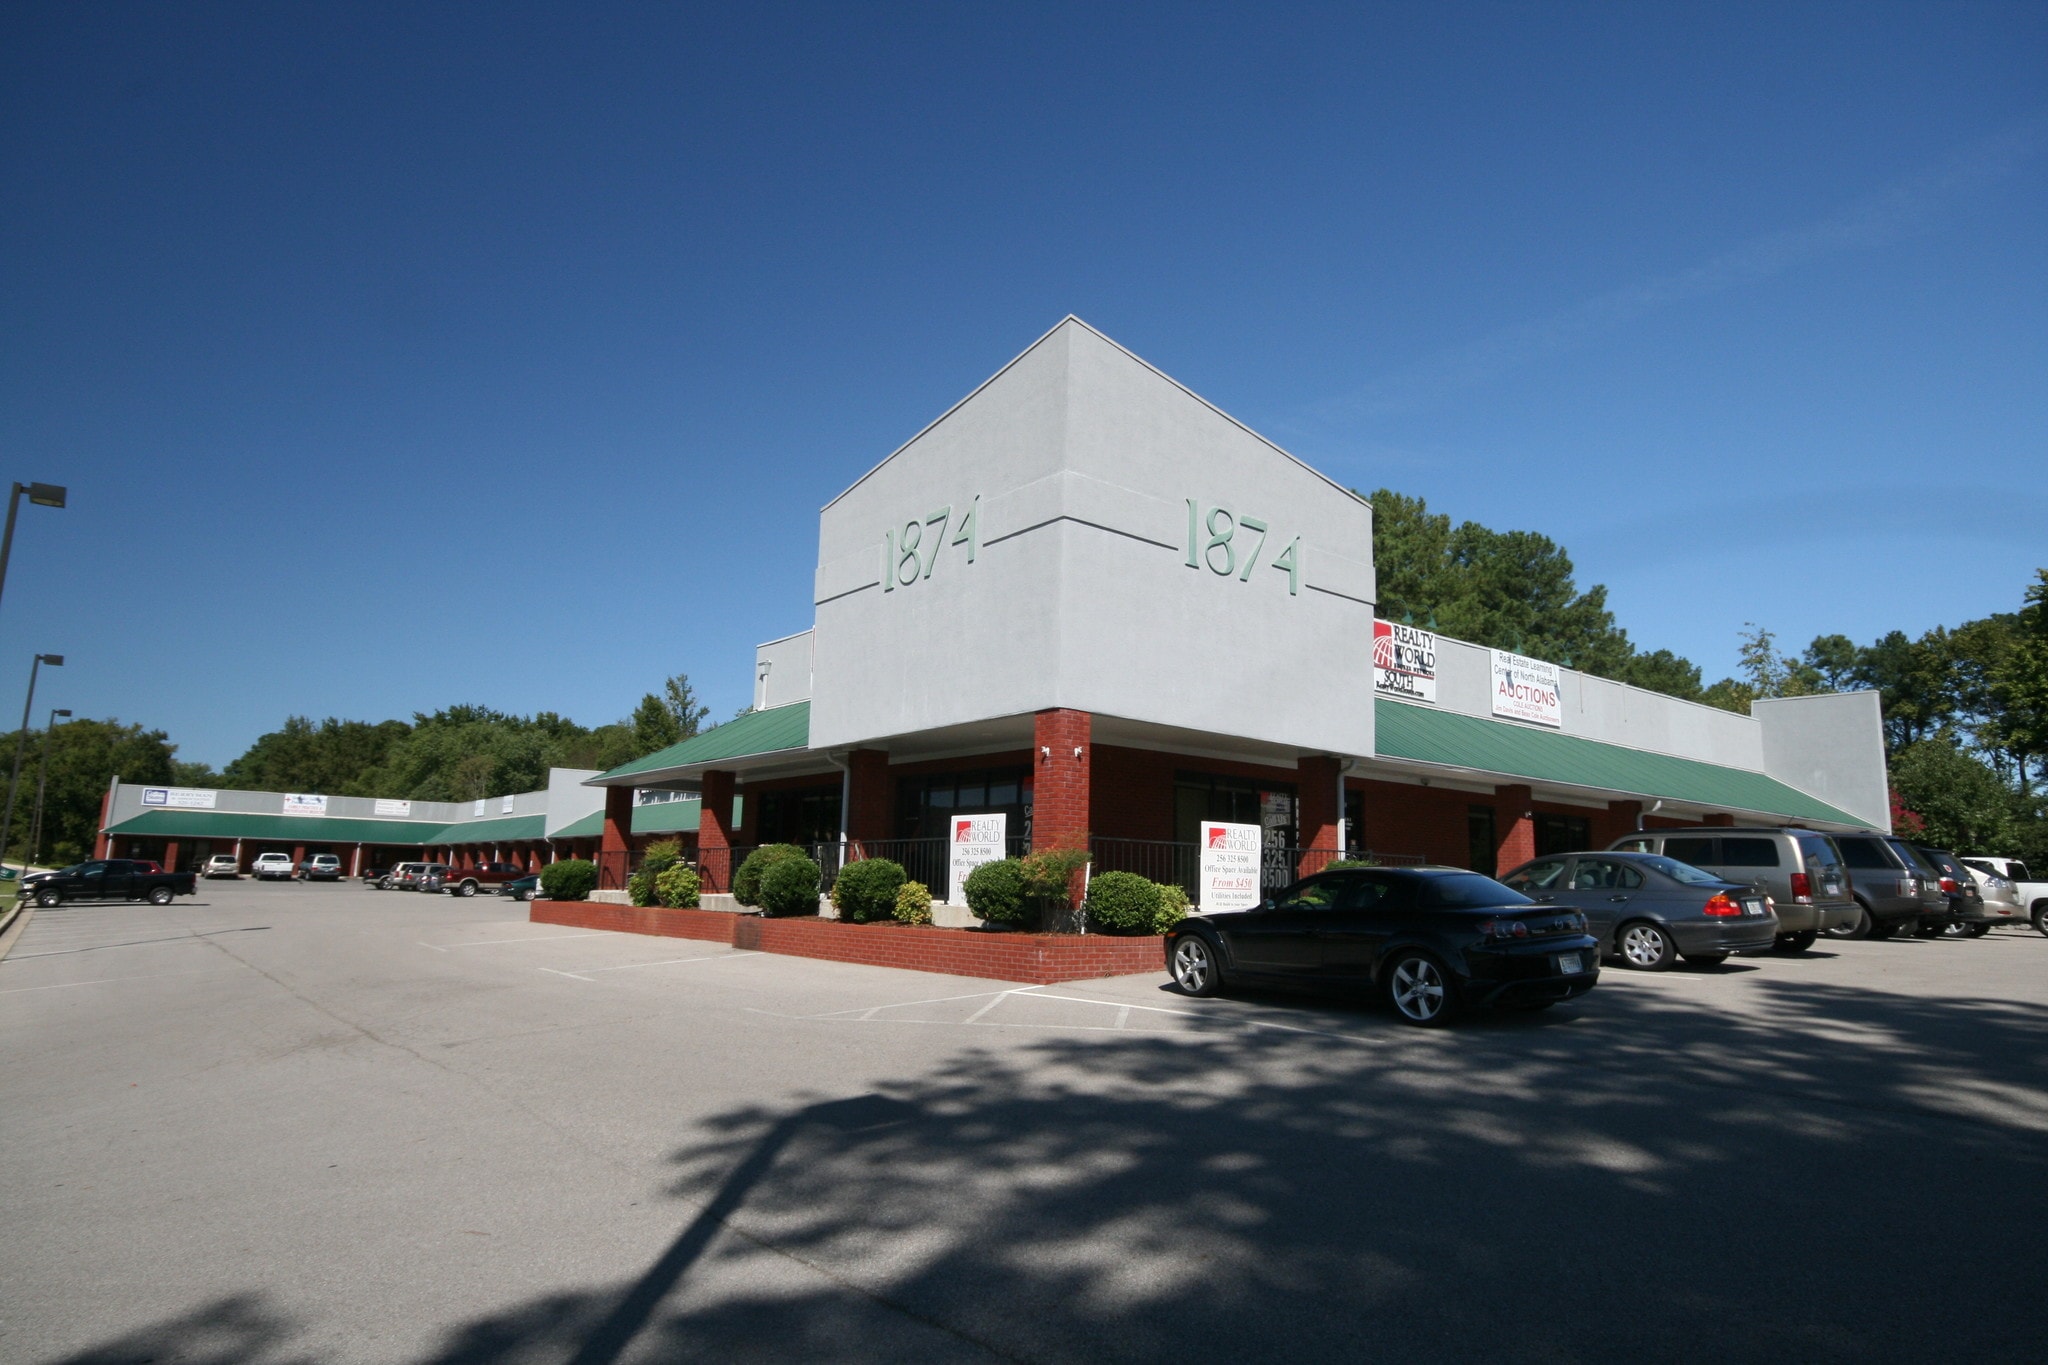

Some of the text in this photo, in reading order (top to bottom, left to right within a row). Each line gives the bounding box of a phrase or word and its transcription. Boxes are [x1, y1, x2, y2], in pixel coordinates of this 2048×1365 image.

[884, 494, 980, 594] 1874
[1185, 498, 1300, 596] 1874
[1393, 625, 1434, 650] REALTY
[1394, 644, 1435, 668] WORLD
[1499, 652, 1552, 676] Real Estate Learning
[1384, 670, 1413, 690] SOUTH
[1514, 670, 1520, 678] of
[1521, 671, 1535, 682] North
[1499, 681, 1556, 707] AUCTIONS
[971, 820, 1000, 831] REALTY
[971, 831, 1000, 843] WORLD
[1227, 828, 1257, 840] REALTY
[1264, 830, 1285, 849] 256
[962, 847, 991, 856] 256 325 8500
[1227, 840, 1257, 851] WORLD
[952, 858, 965, 867] Office
[966, 859, 978, 869] Space
[1216, 854, 1249, 864] 256 325 8500
[1204, 864, 1258, 875] Office Space Available
[1211, 877, 1253, 889] From $450
[1211, 892, 1253, 900] Utilities Included
